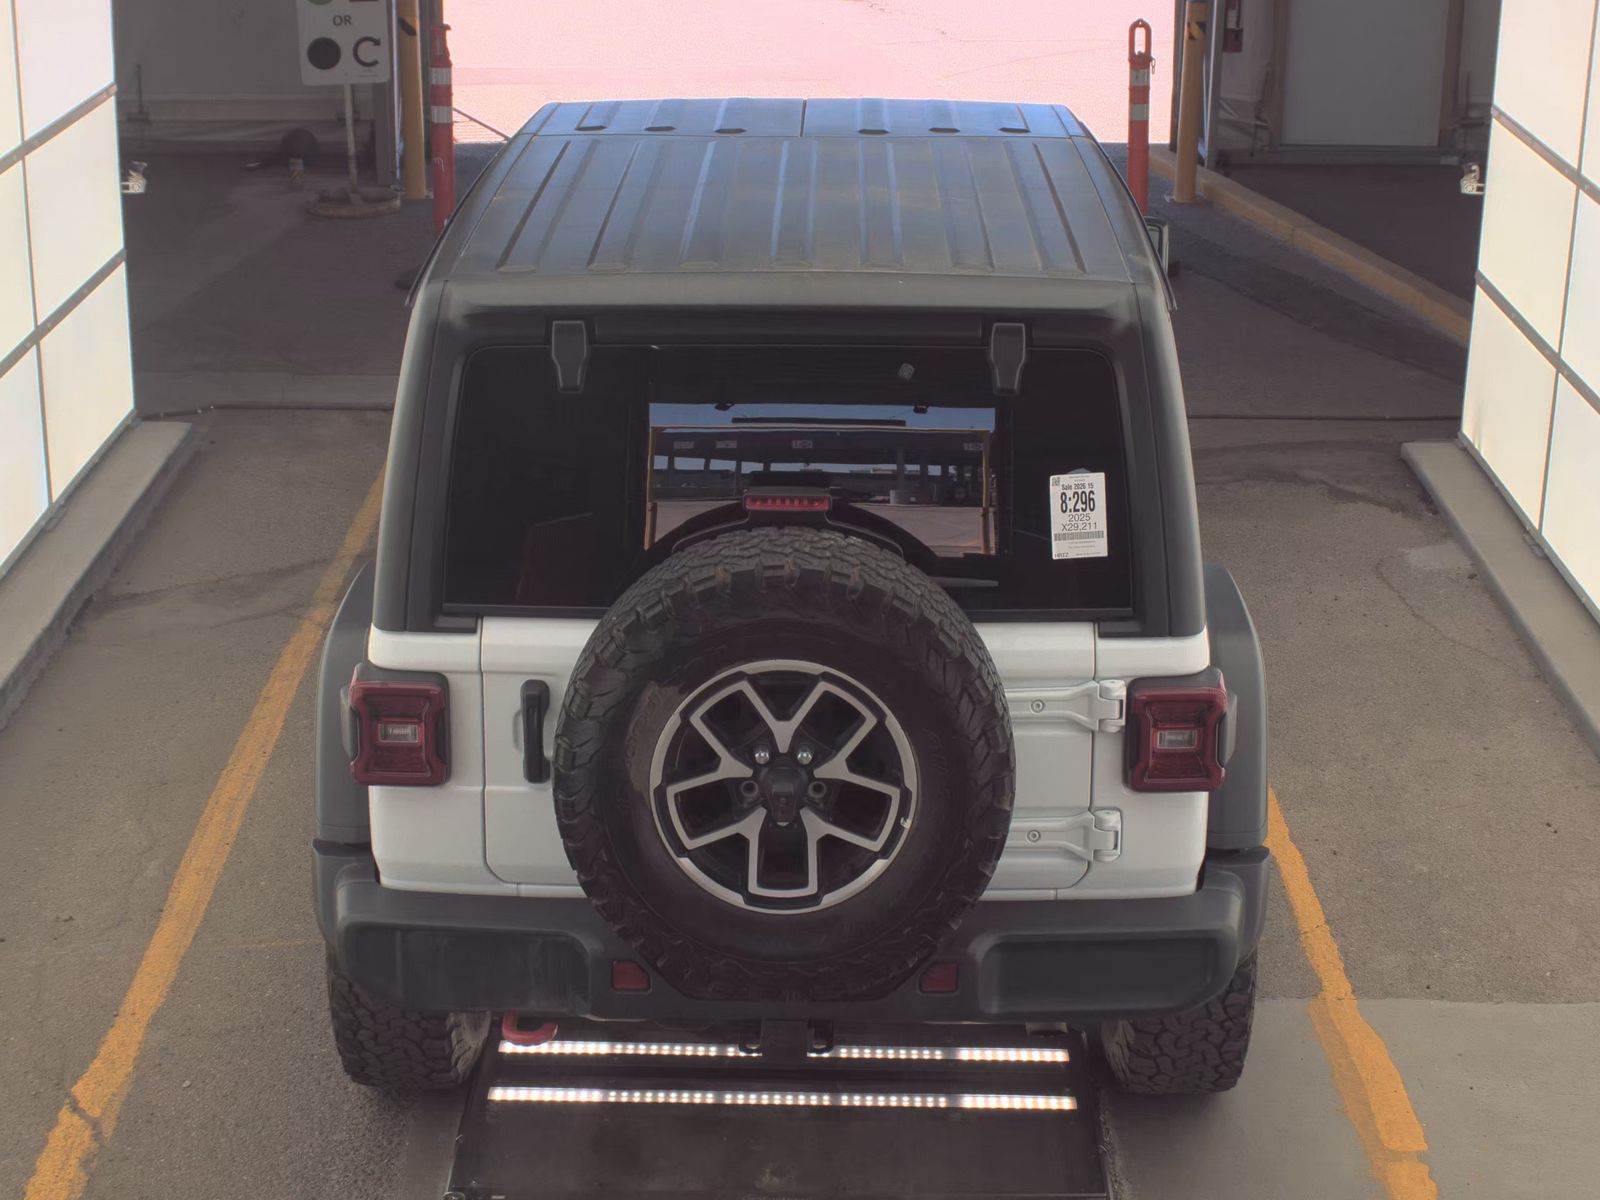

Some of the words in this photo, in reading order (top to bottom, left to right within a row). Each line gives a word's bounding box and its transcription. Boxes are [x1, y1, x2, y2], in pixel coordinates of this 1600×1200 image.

[332, 15, 352, 27] OR
[1060, 490, 1096, 514] 8:296
[1068, 513, 1091, 523] 2025
[1061, 522, 1097, 532] X29,211
